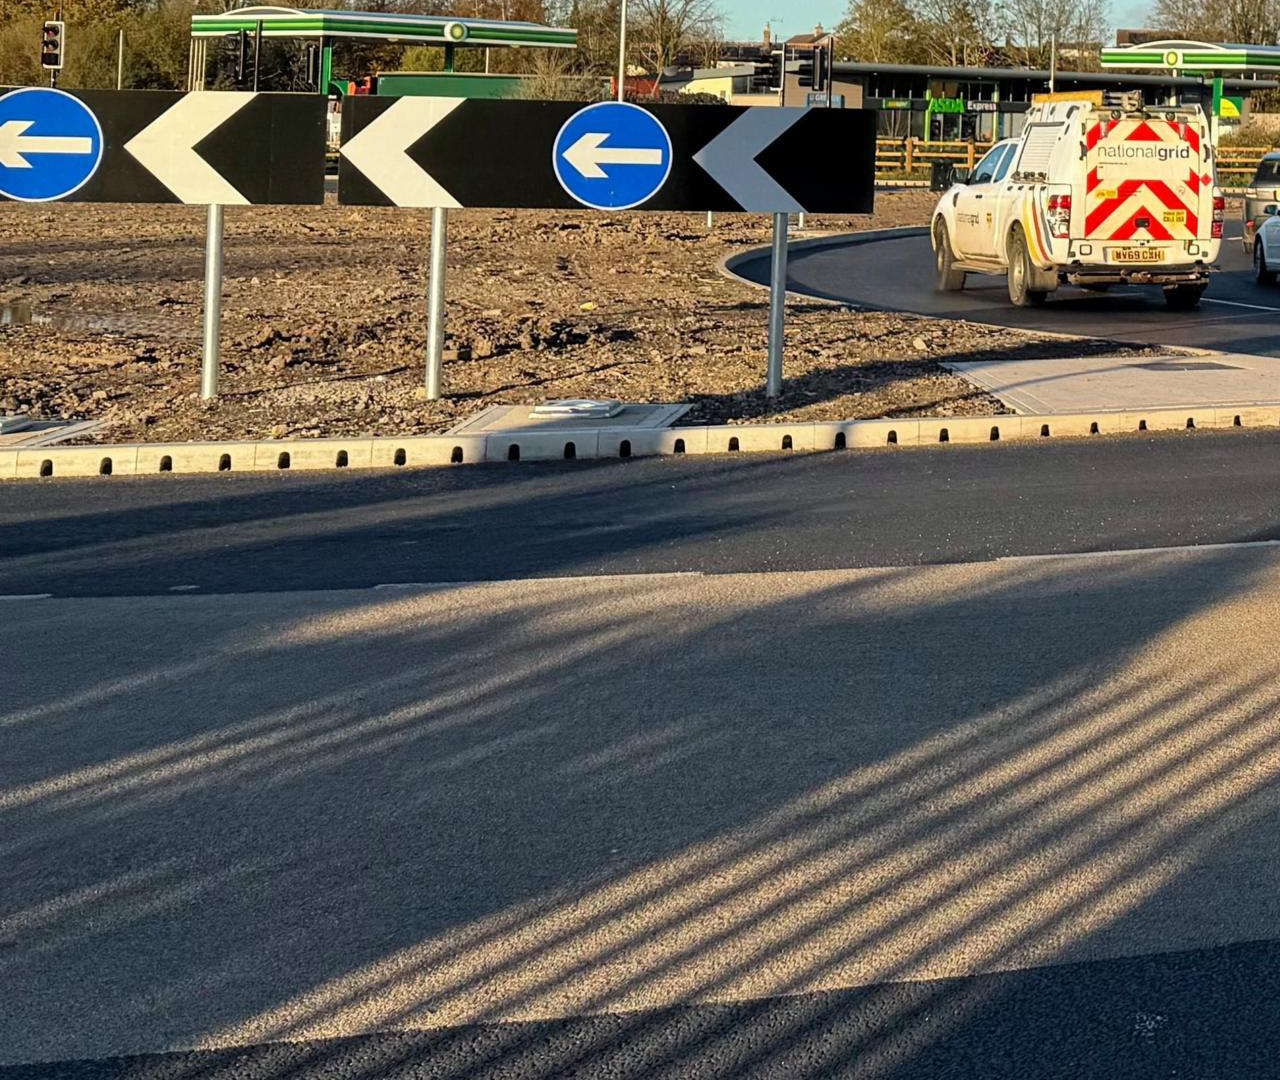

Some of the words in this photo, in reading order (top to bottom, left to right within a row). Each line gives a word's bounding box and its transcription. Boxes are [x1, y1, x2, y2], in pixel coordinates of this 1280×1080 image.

[931, 98, 965, 113] ASDA
[967, 100, 997, 111] Express
[1097, 145, 1190, 161] nationalgrid
